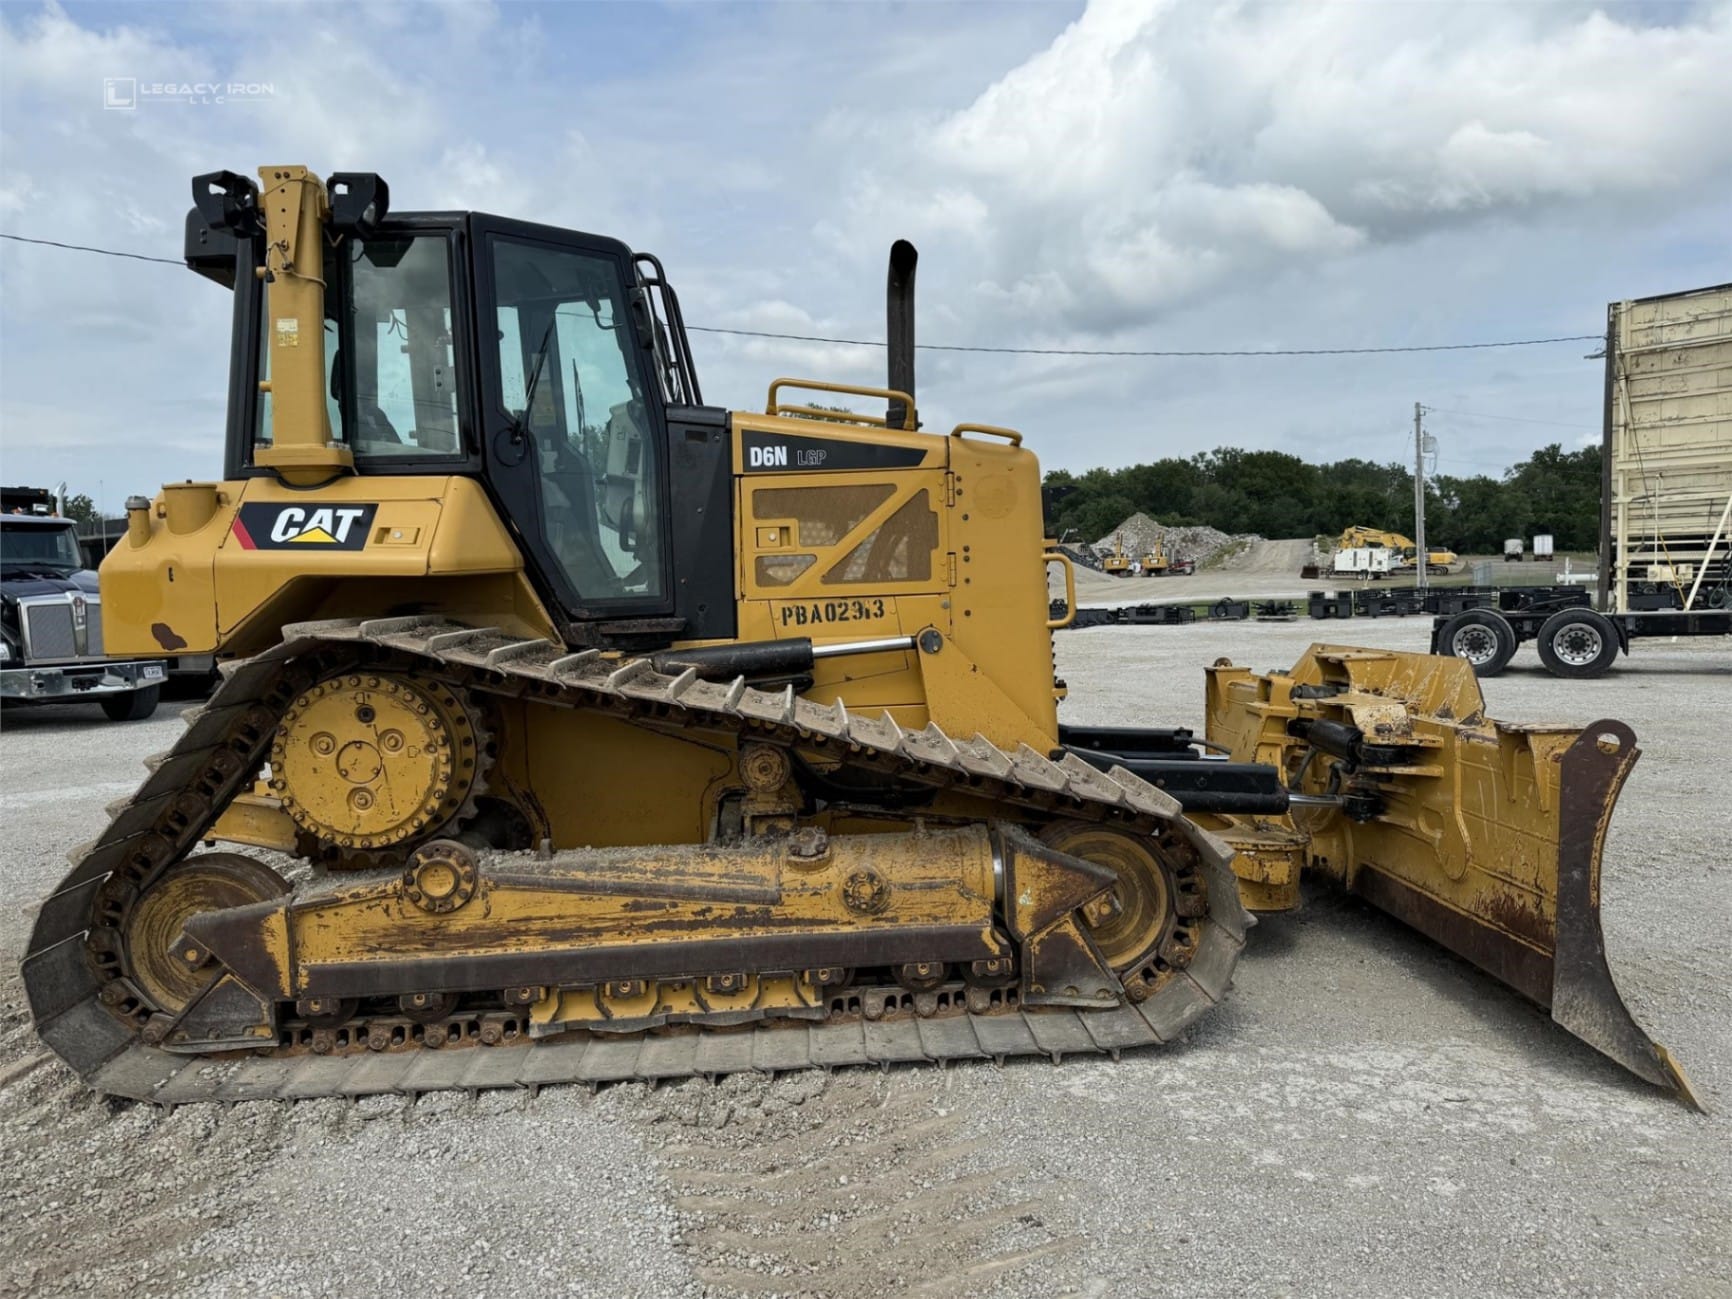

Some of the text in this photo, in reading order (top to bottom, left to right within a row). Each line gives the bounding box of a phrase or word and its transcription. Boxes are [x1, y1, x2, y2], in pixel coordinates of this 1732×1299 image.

[750, 446, 828, 467] D6N LGP
[270, 507, 364, 544] CAT
